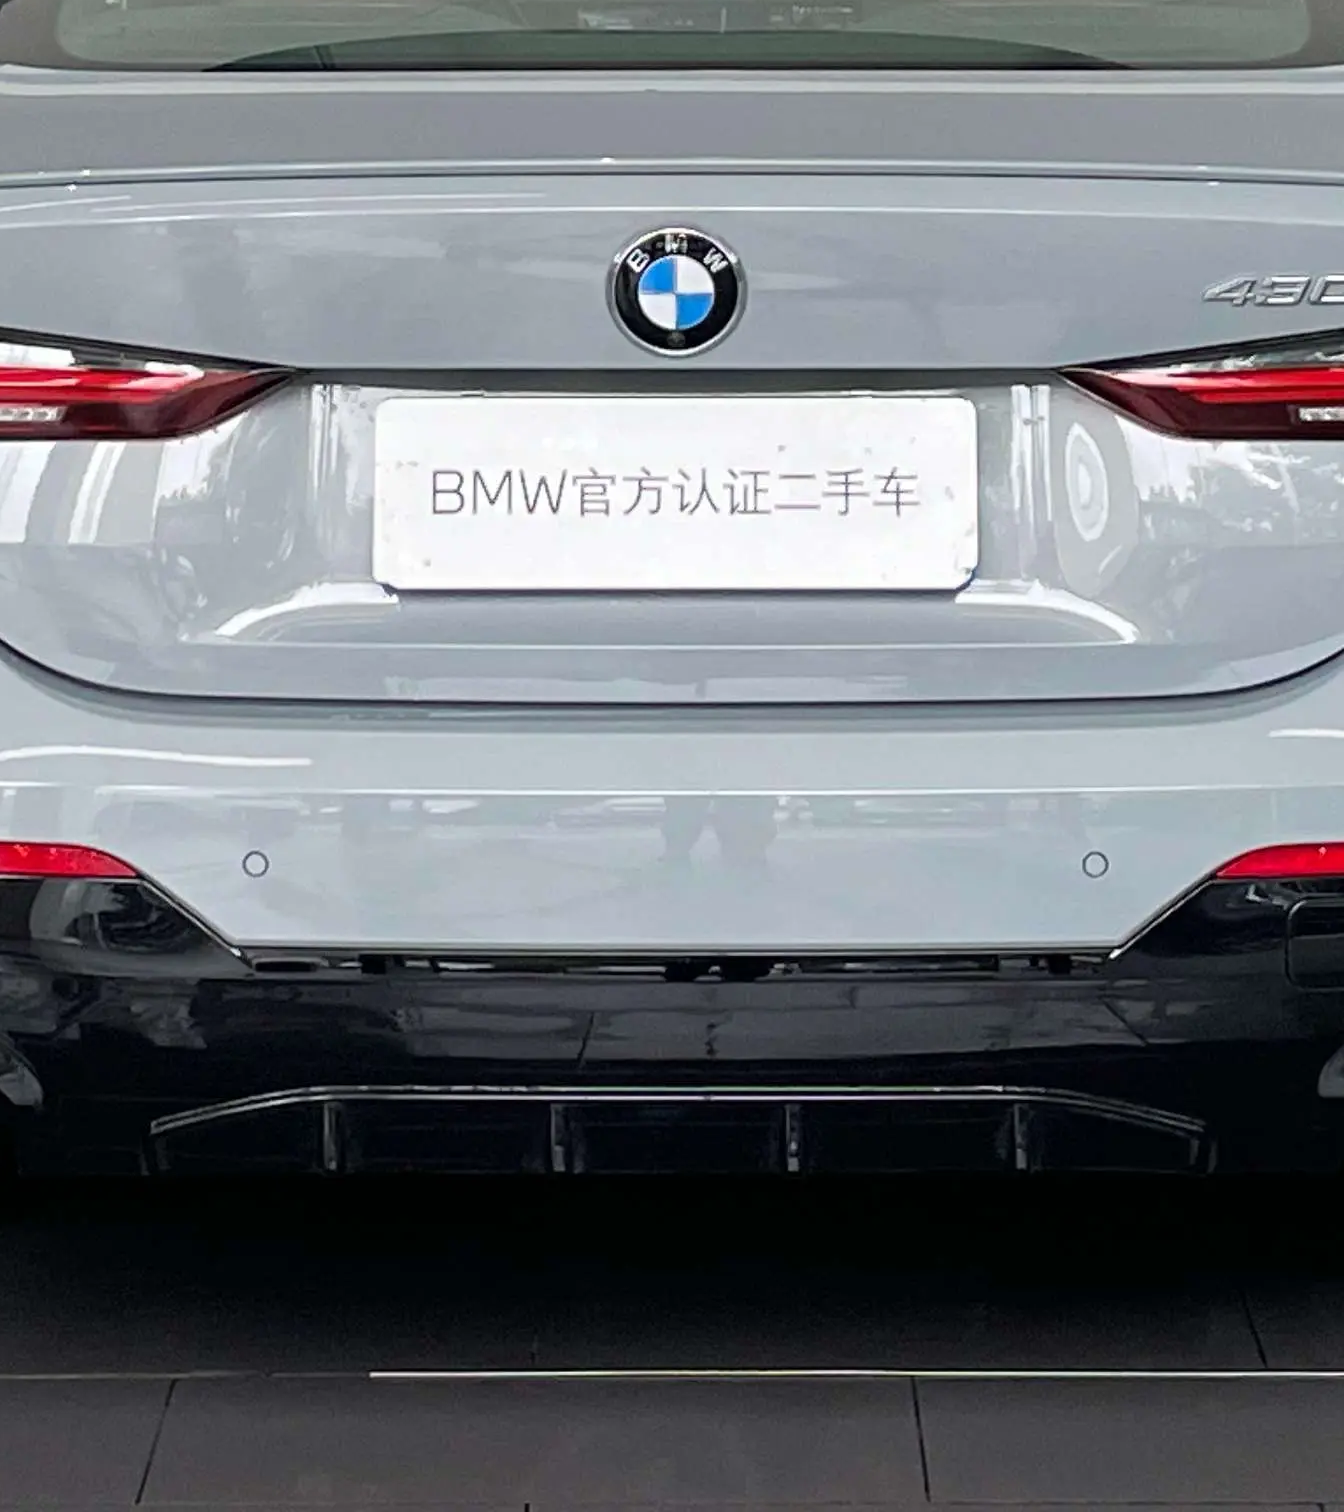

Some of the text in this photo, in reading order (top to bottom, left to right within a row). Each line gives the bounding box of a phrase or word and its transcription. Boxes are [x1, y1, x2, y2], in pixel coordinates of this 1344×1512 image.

[625, 233, 730, 274] BMW
[430, 466, 921, 518] BMW官方认证二手车
